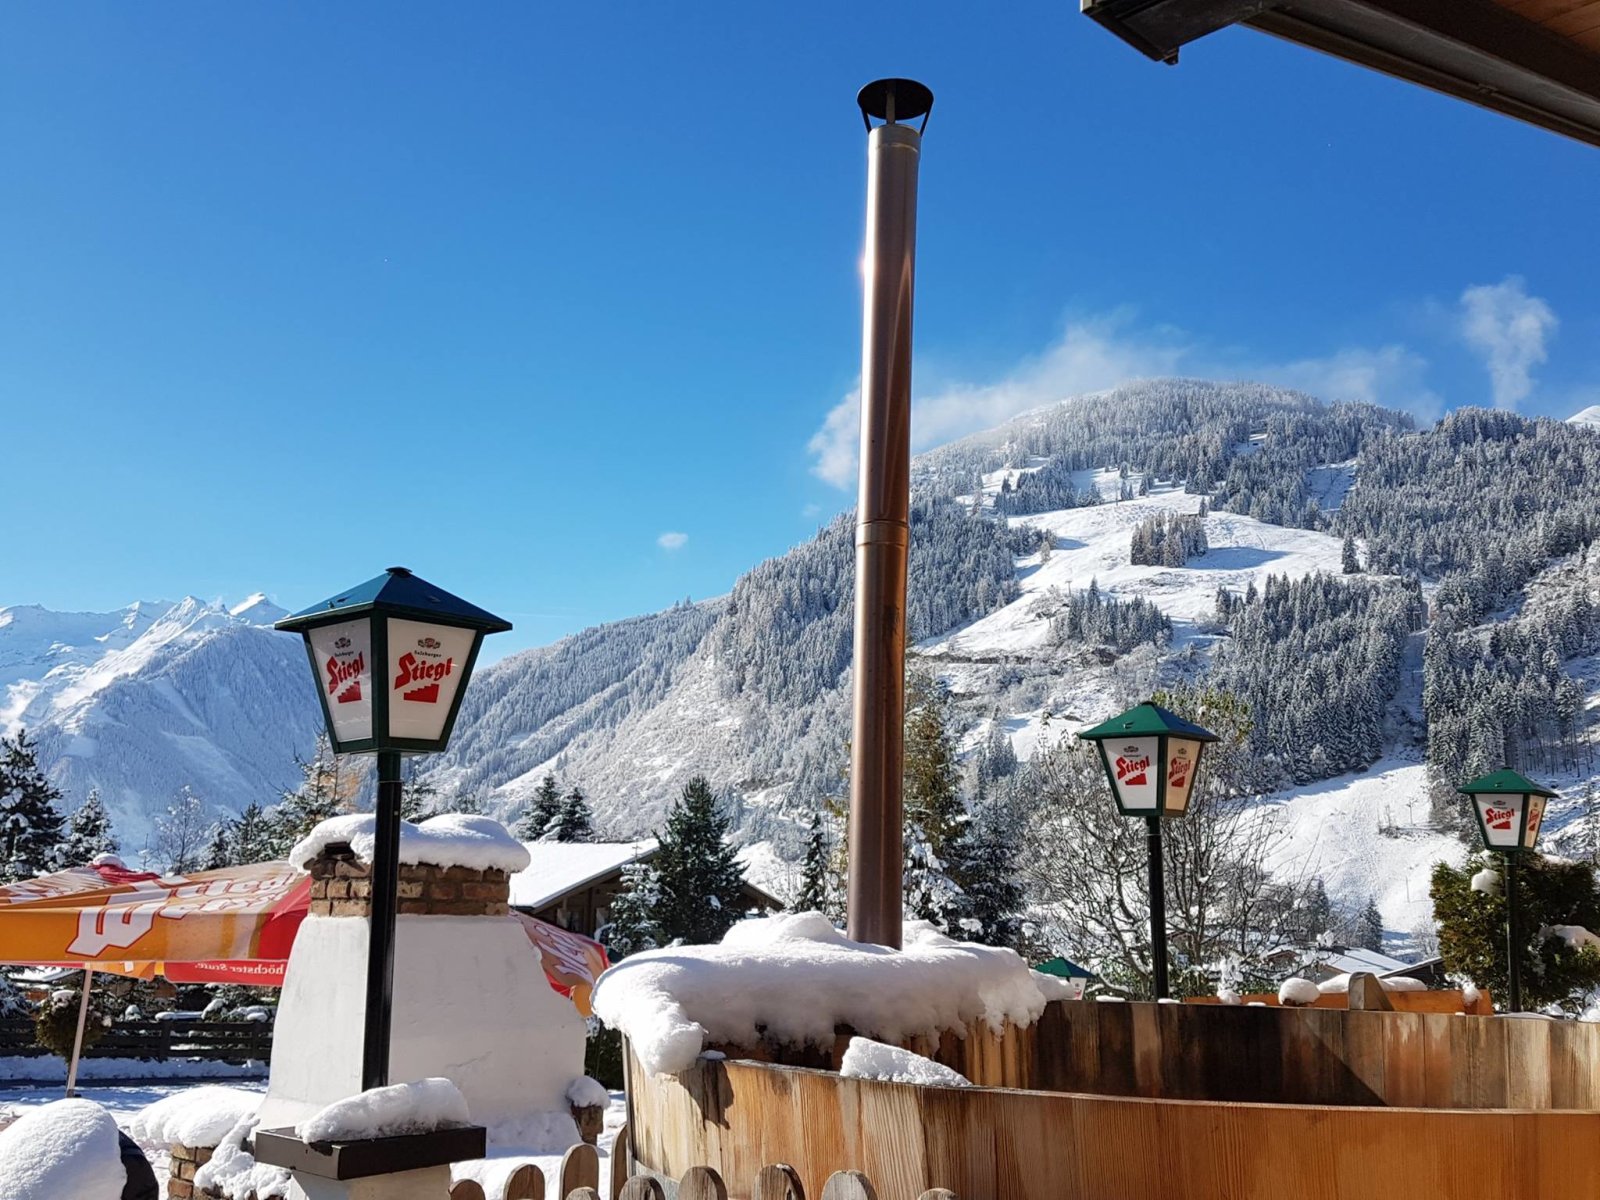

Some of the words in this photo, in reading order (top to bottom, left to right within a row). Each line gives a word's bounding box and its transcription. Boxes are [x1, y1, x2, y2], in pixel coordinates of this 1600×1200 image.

[327, 651, 365, 695] Stiegl
[394, 652, 453, 690] Stiegl
[1115, 755, 1151, 780] Stiegl
[1169, 757, 1191, 780] Stiegl
[1485, 807, 1515, 825] Stiegl
